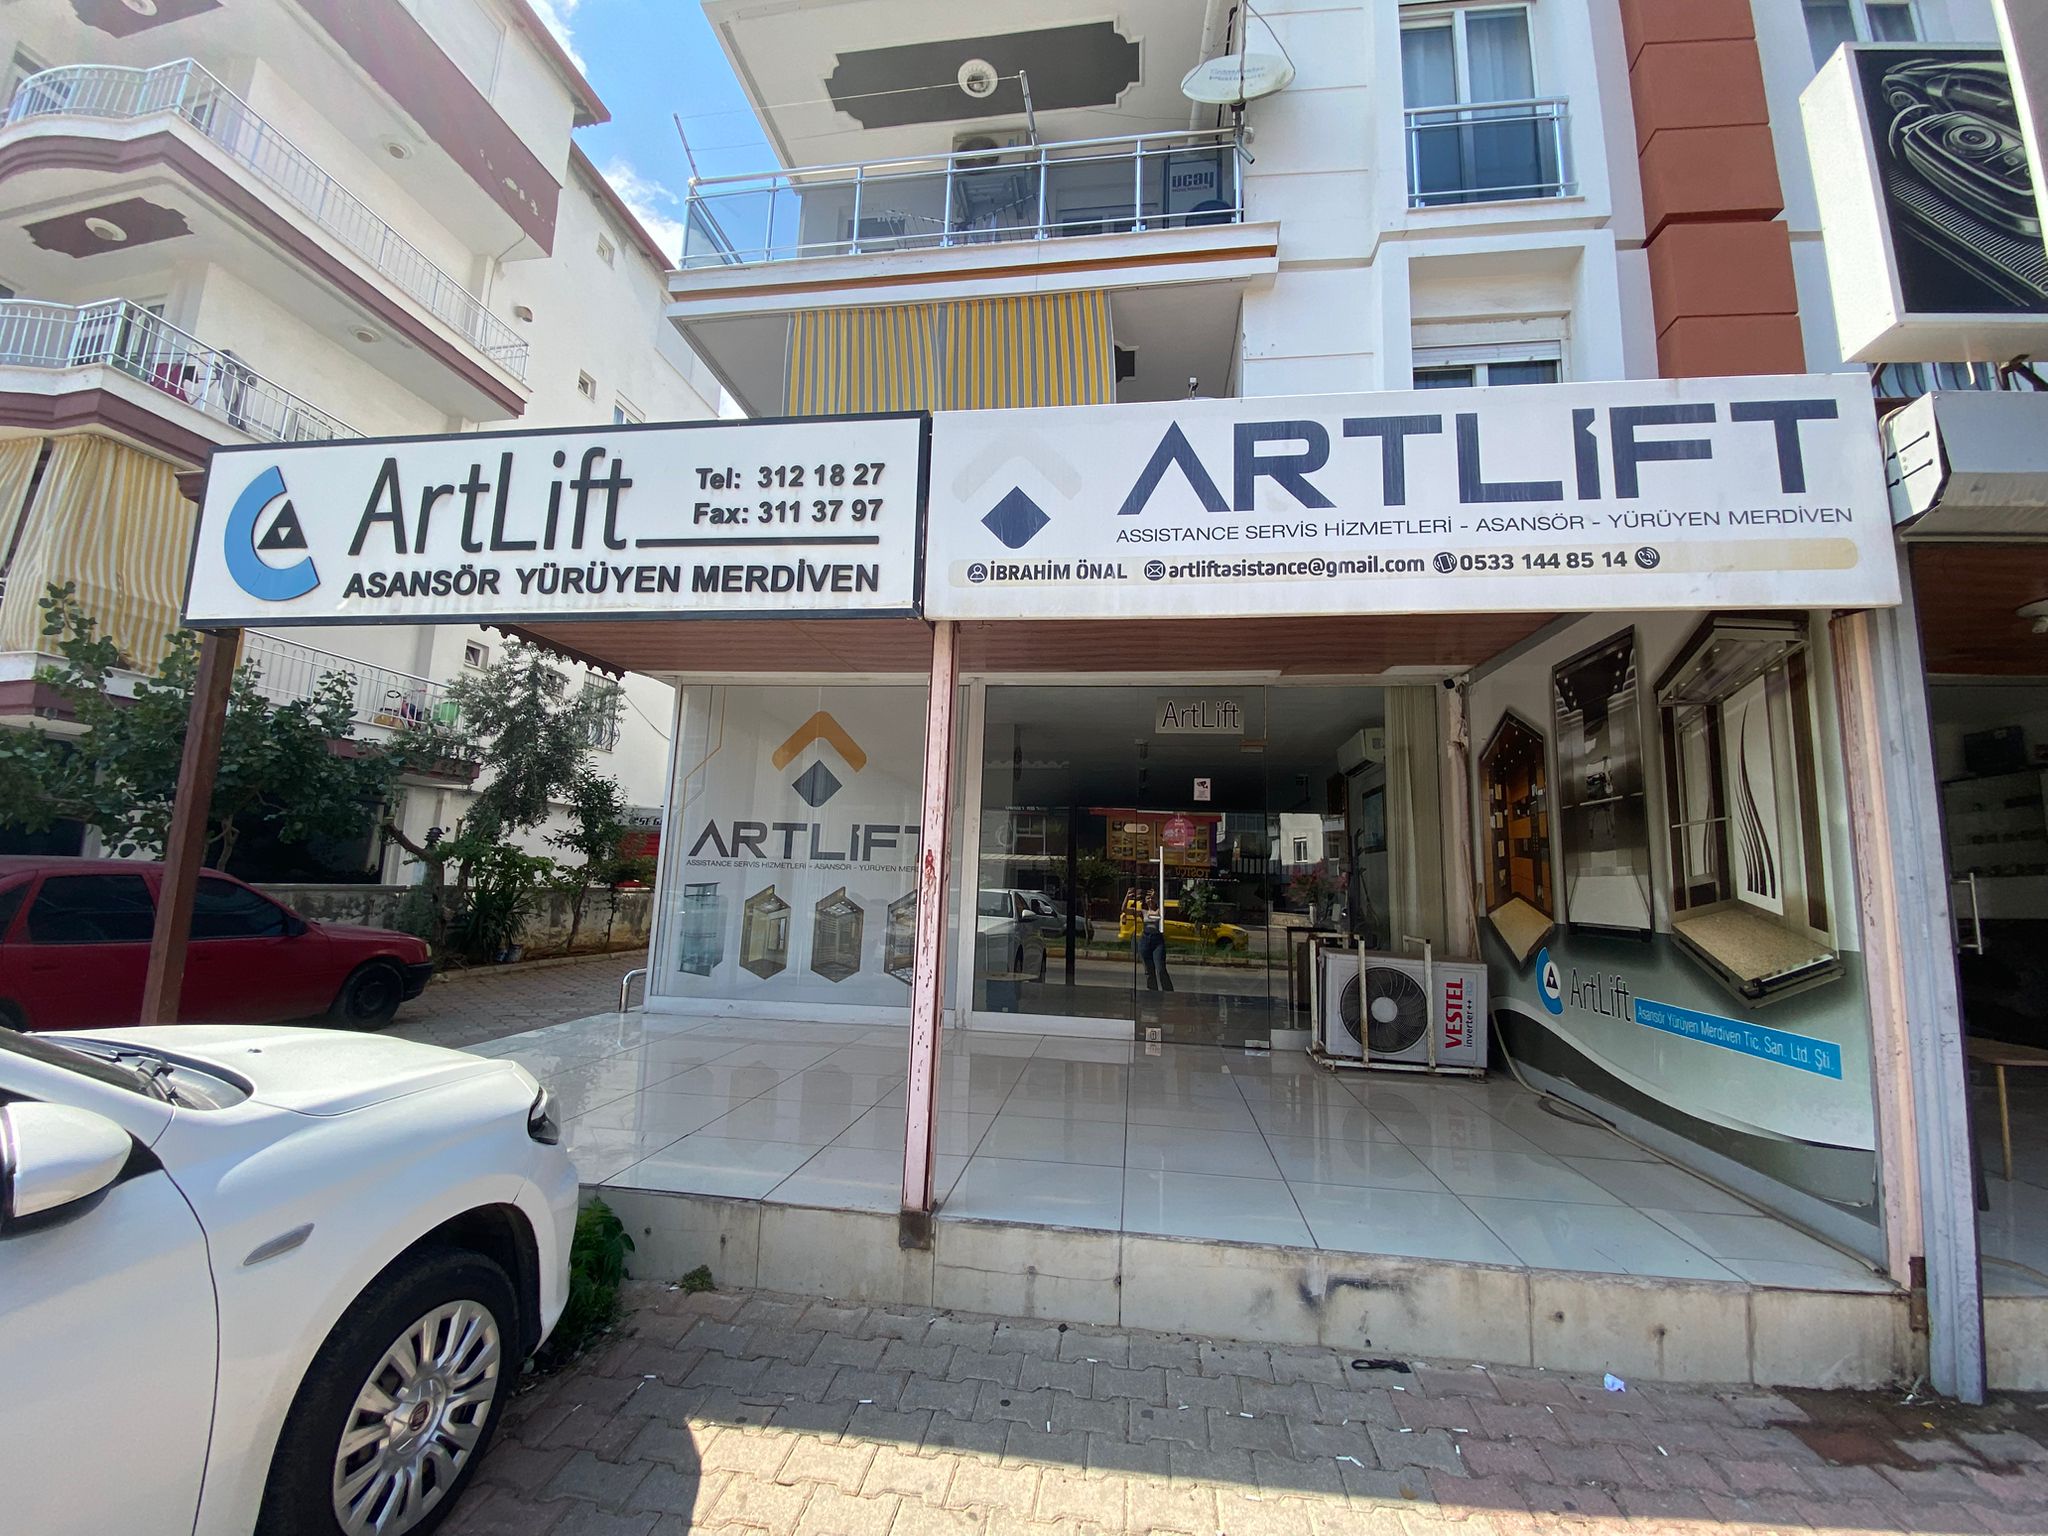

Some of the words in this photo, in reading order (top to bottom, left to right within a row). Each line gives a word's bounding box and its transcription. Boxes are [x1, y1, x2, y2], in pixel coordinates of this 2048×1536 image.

[696, 467, 741, 490] Tel:
[757, 464, 804, 489] 312
[814, 463, 845, 487] 18
[852, 462, 886, 486] 27
[1117, 400, 1838, 515] ARTLIFT
[347, 446, 633, 557] ArtLift
[693, 502, 749, 525] Fax:
[757, 500, 801, 524] 311
[811, 499, 844, 523] 37
[851, 498, 884, 522] 97
[1116, 526, 1240, 544] ASSISTANCE
[1245, 520, 1318, 540] SERVİS
[1324, 515, 1453, 537] HİZMETLERİ
[1475, 512, 1585, 532] ASANSÖR
[1608, 509, 1721, 529] YÜRÜYEN
[1728, 505, 1853, 525] MERDİVEN
[343, 563, 501, 599] ASANSÖR
[515, 560, 682, 595] YÜRÜYEN
[691, 558, 880, 593] MERDİVEN
[989, 560, 1071, 581] İBRAHİM
[1076, 560, 1128, 580] ÖNAL
[1168, 556, 1425, 579] artliftasistance@gmail.com
[1460, 558, 1515, 571] 0533
[1521, 554, 1561, 570] 144
[1566, 552, 1594, 568] 85
[1601, 551, 1628, 567] 14
[1161, 700, 1240, 729] ArtLift
[1445, 978, 1463, 1049] VESTEL
[1570, 968, 1631, 1022] ArtLift
[1763, 1035, 1787, 1058] San.
[1790, 1042, 1811, 1064] Ltd.
